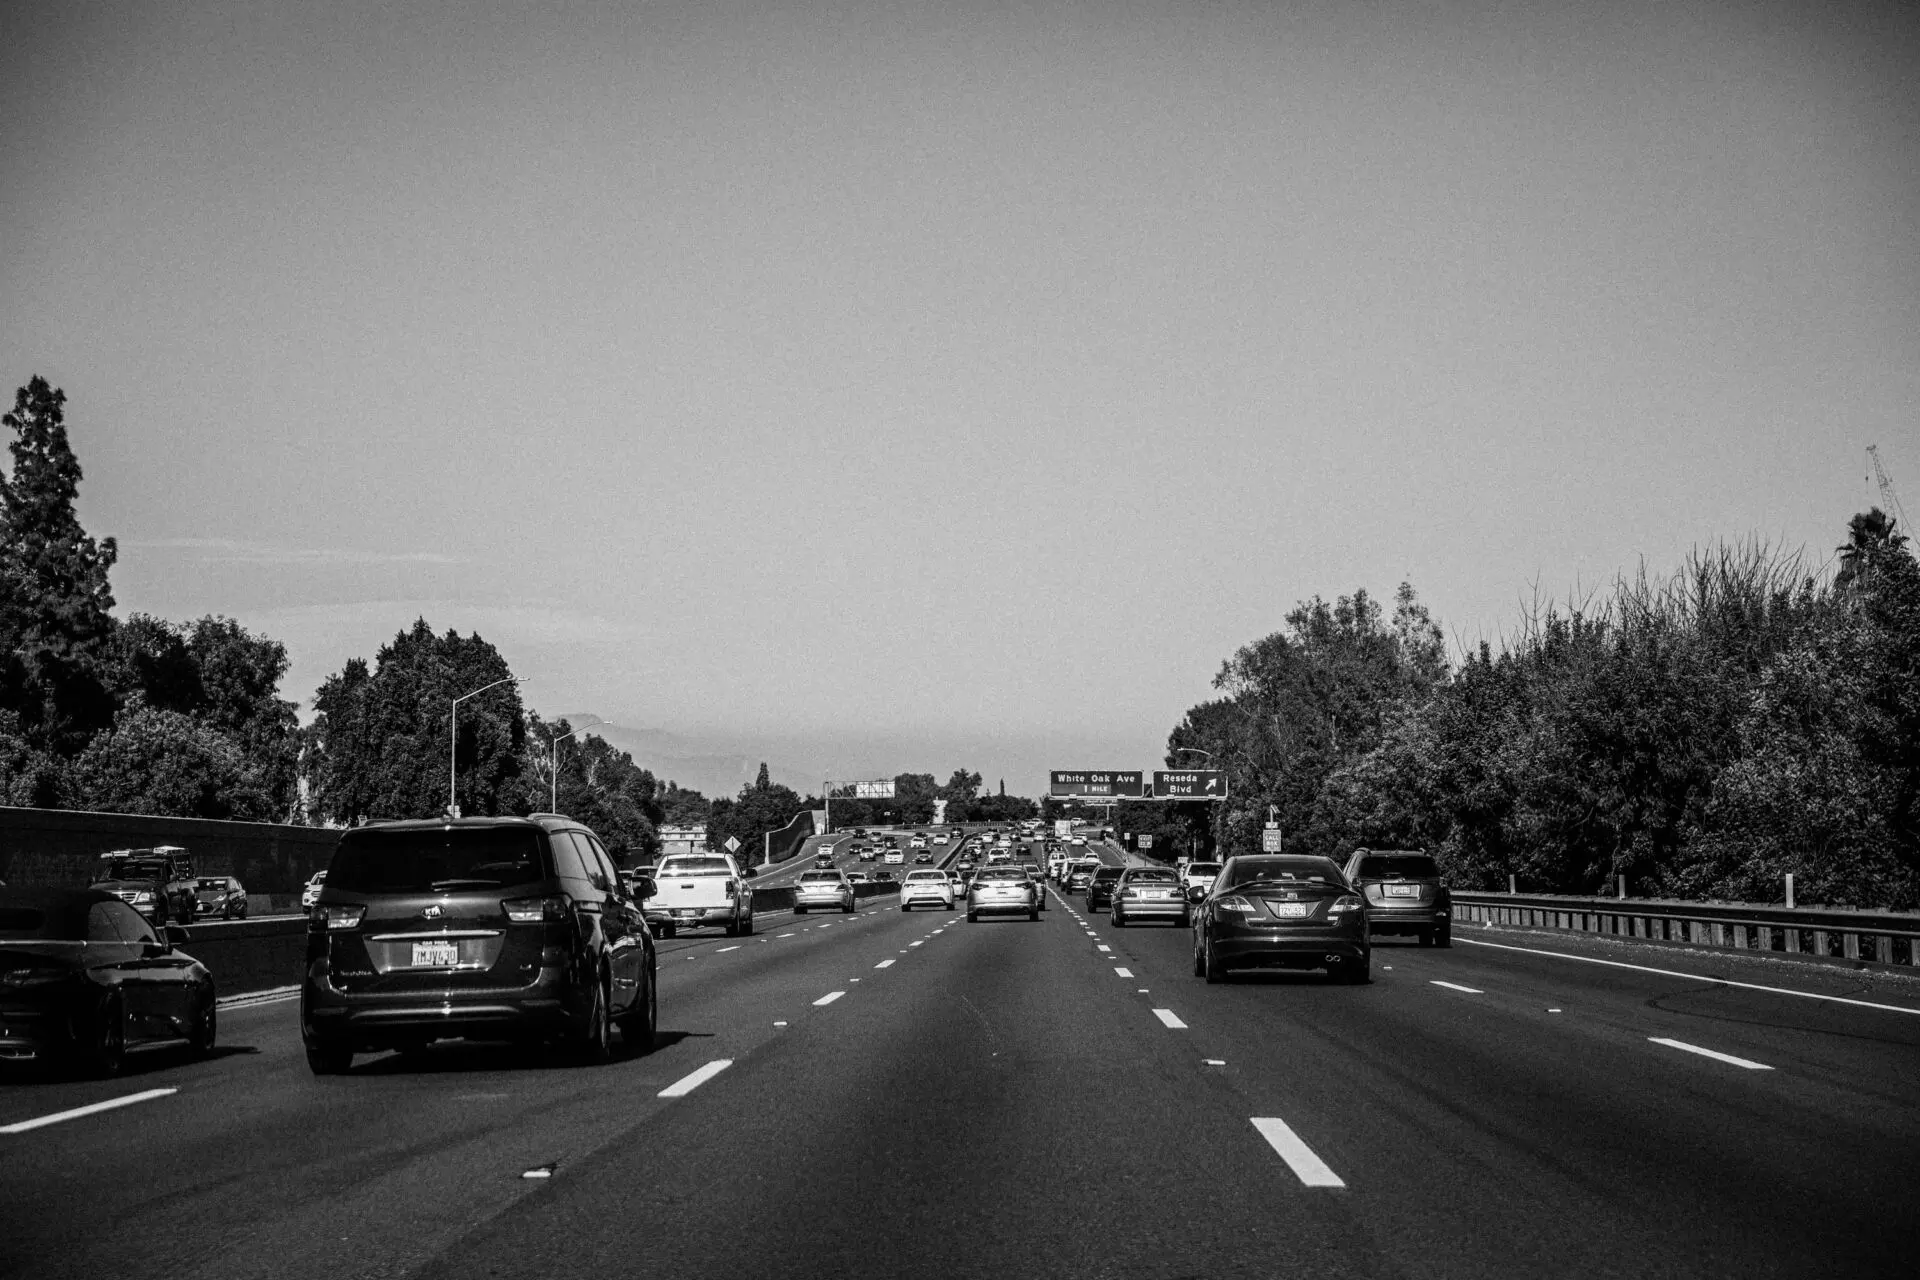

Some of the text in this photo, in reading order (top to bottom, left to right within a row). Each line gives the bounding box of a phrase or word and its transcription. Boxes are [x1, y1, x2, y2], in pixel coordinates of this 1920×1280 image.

[1058, 774, 1135, 782] White Oak Ave
[1163, 774, 1197, 782] Reseda
[1084, 785, 1088, 793] 1
[1169, 785, 1192, 793] Blvd
[425, 905, 441, 916] KIA
